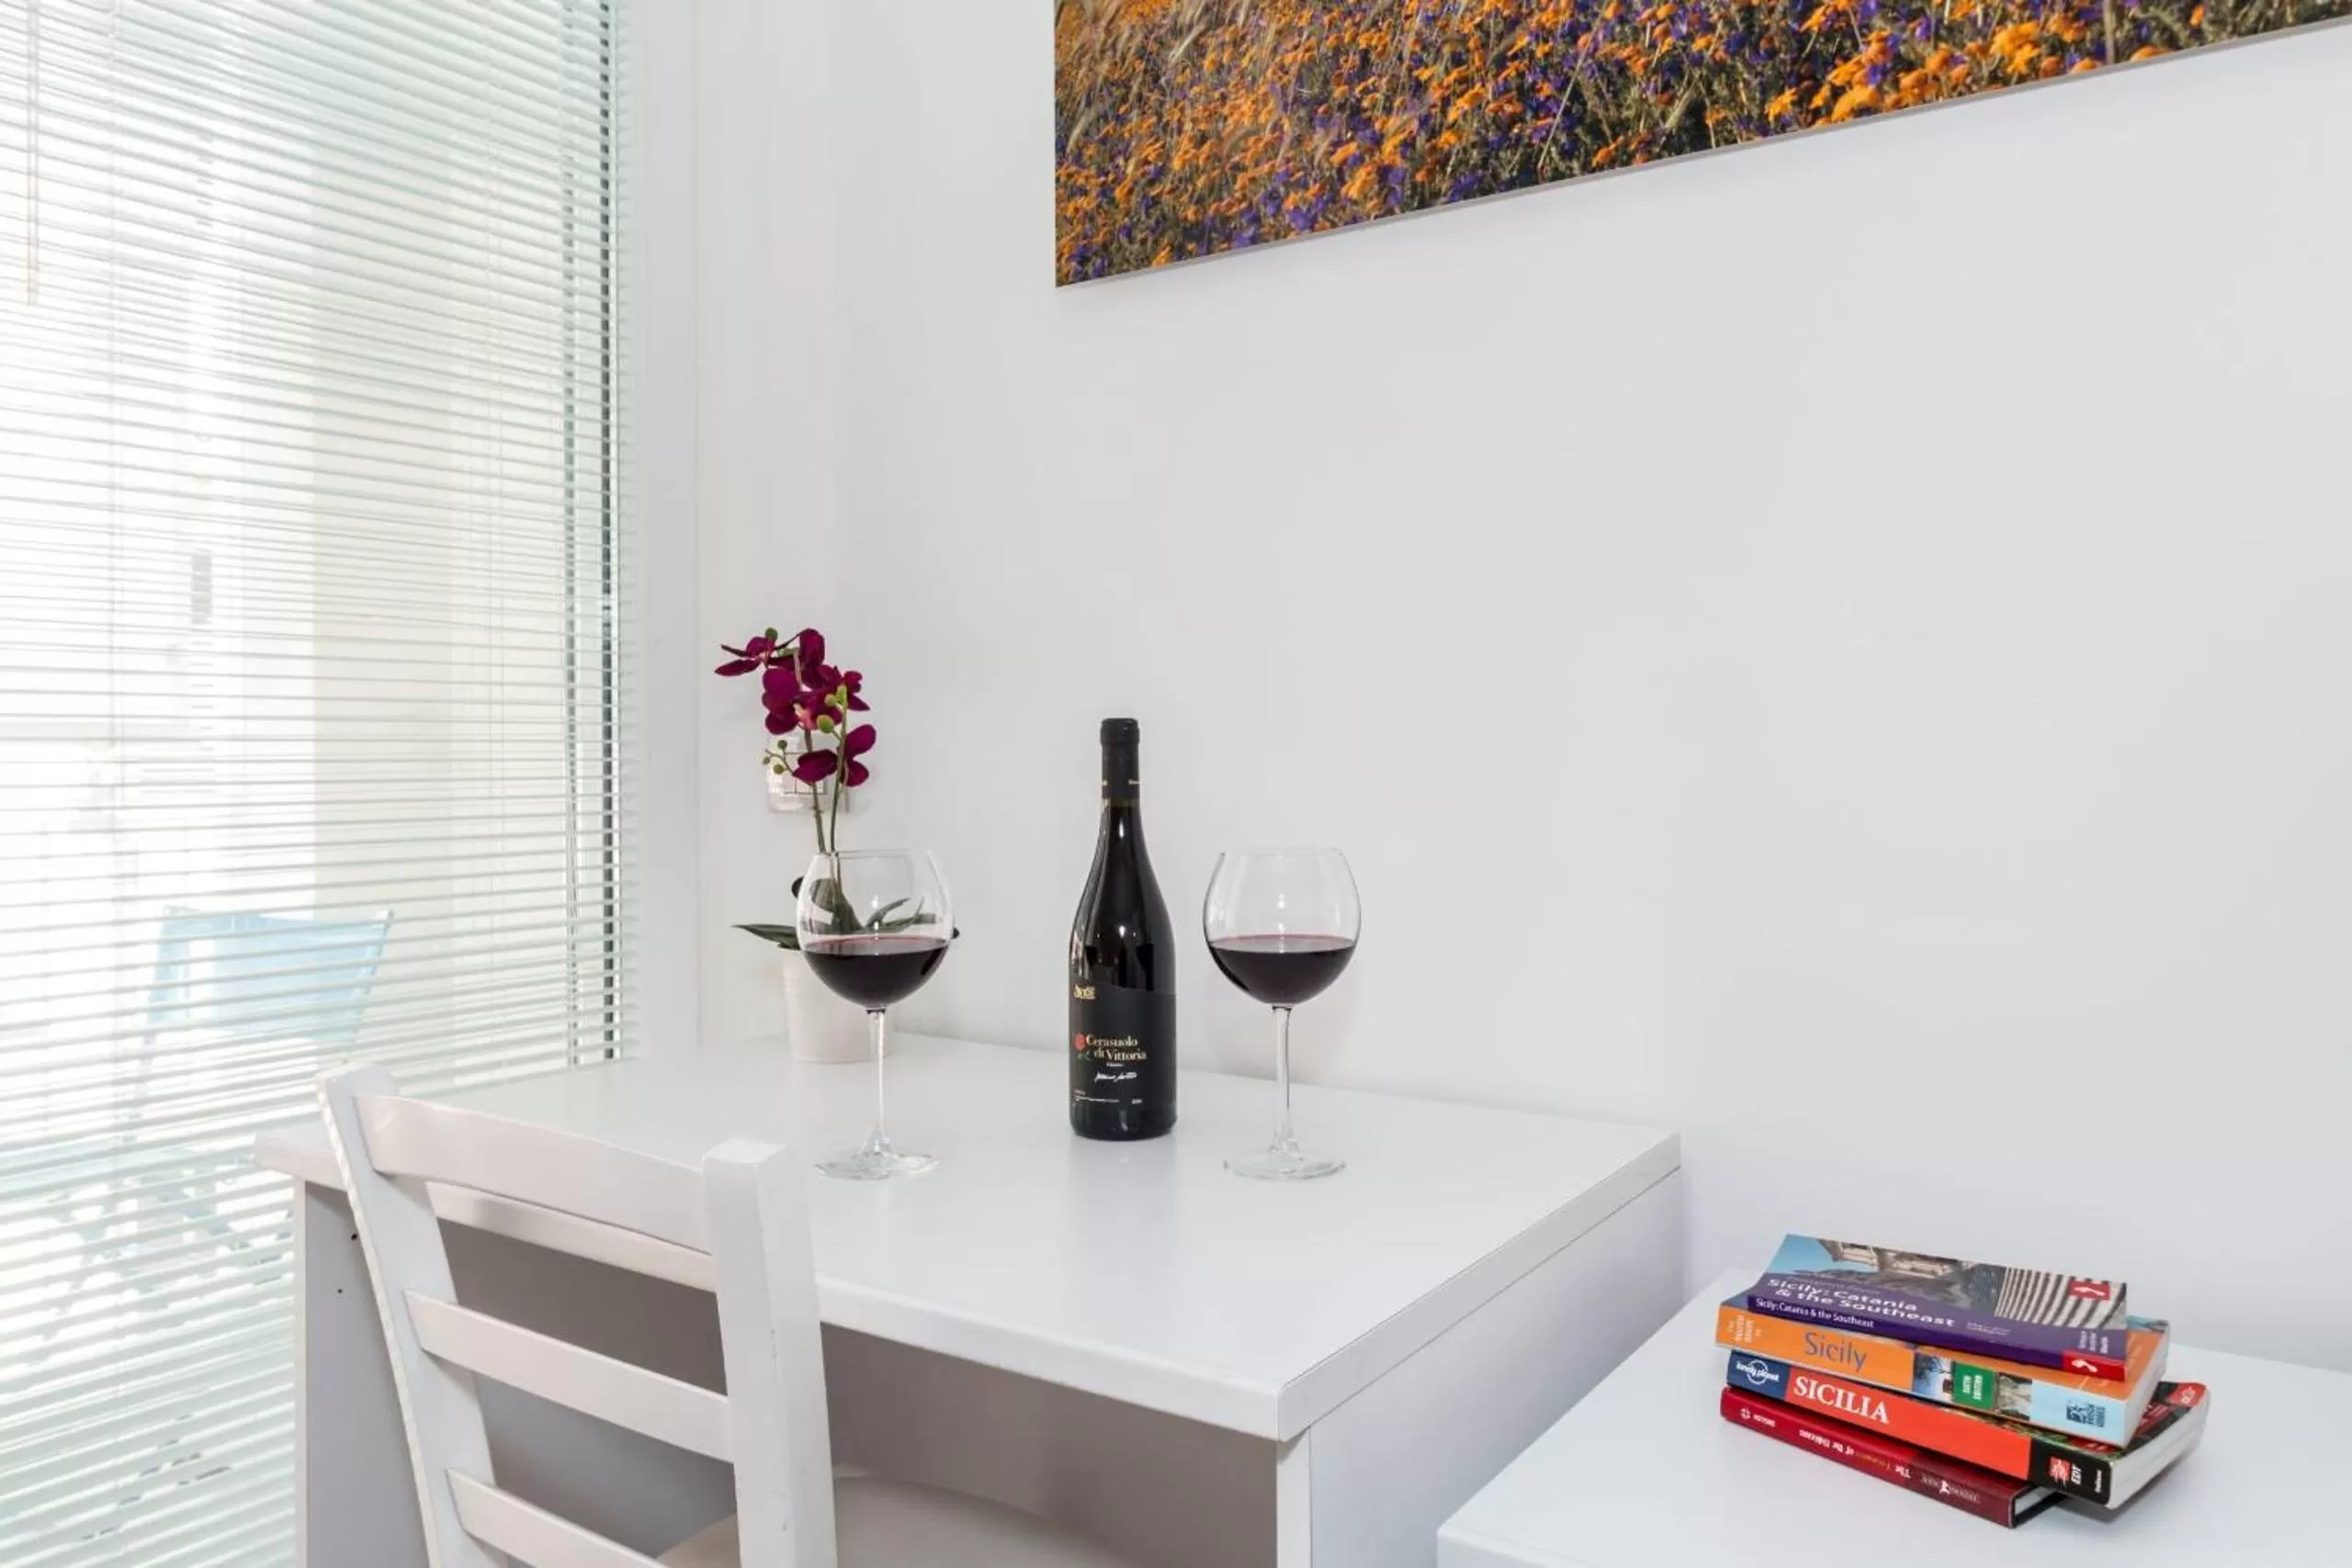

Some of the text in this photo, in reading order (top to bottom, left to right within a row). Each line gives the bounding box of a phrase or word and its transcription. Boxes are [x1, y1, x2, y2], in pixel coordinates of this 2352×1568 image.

[1086, 1033, 1138, 1047] Cerasuolo
[1093, 1046, 1147, 1061] di Vittoria
[1768, 1278, 1829, 1297] Sicily:
[1833, 1290, 1918, 1312] Catania
[1775, 1288, 1956, 1327] & the Southeast
[1756, 1298, 1874, 1328] Sicily: Catania & the Southeast
[1804, 1331, 1868, 1372] Sicily
[1736, 1360, 1780, 1382] lonely planet
[1792, 1376, 1890, 1425] SICILIA
[2071, 1464, 2082, 1484] EDT
